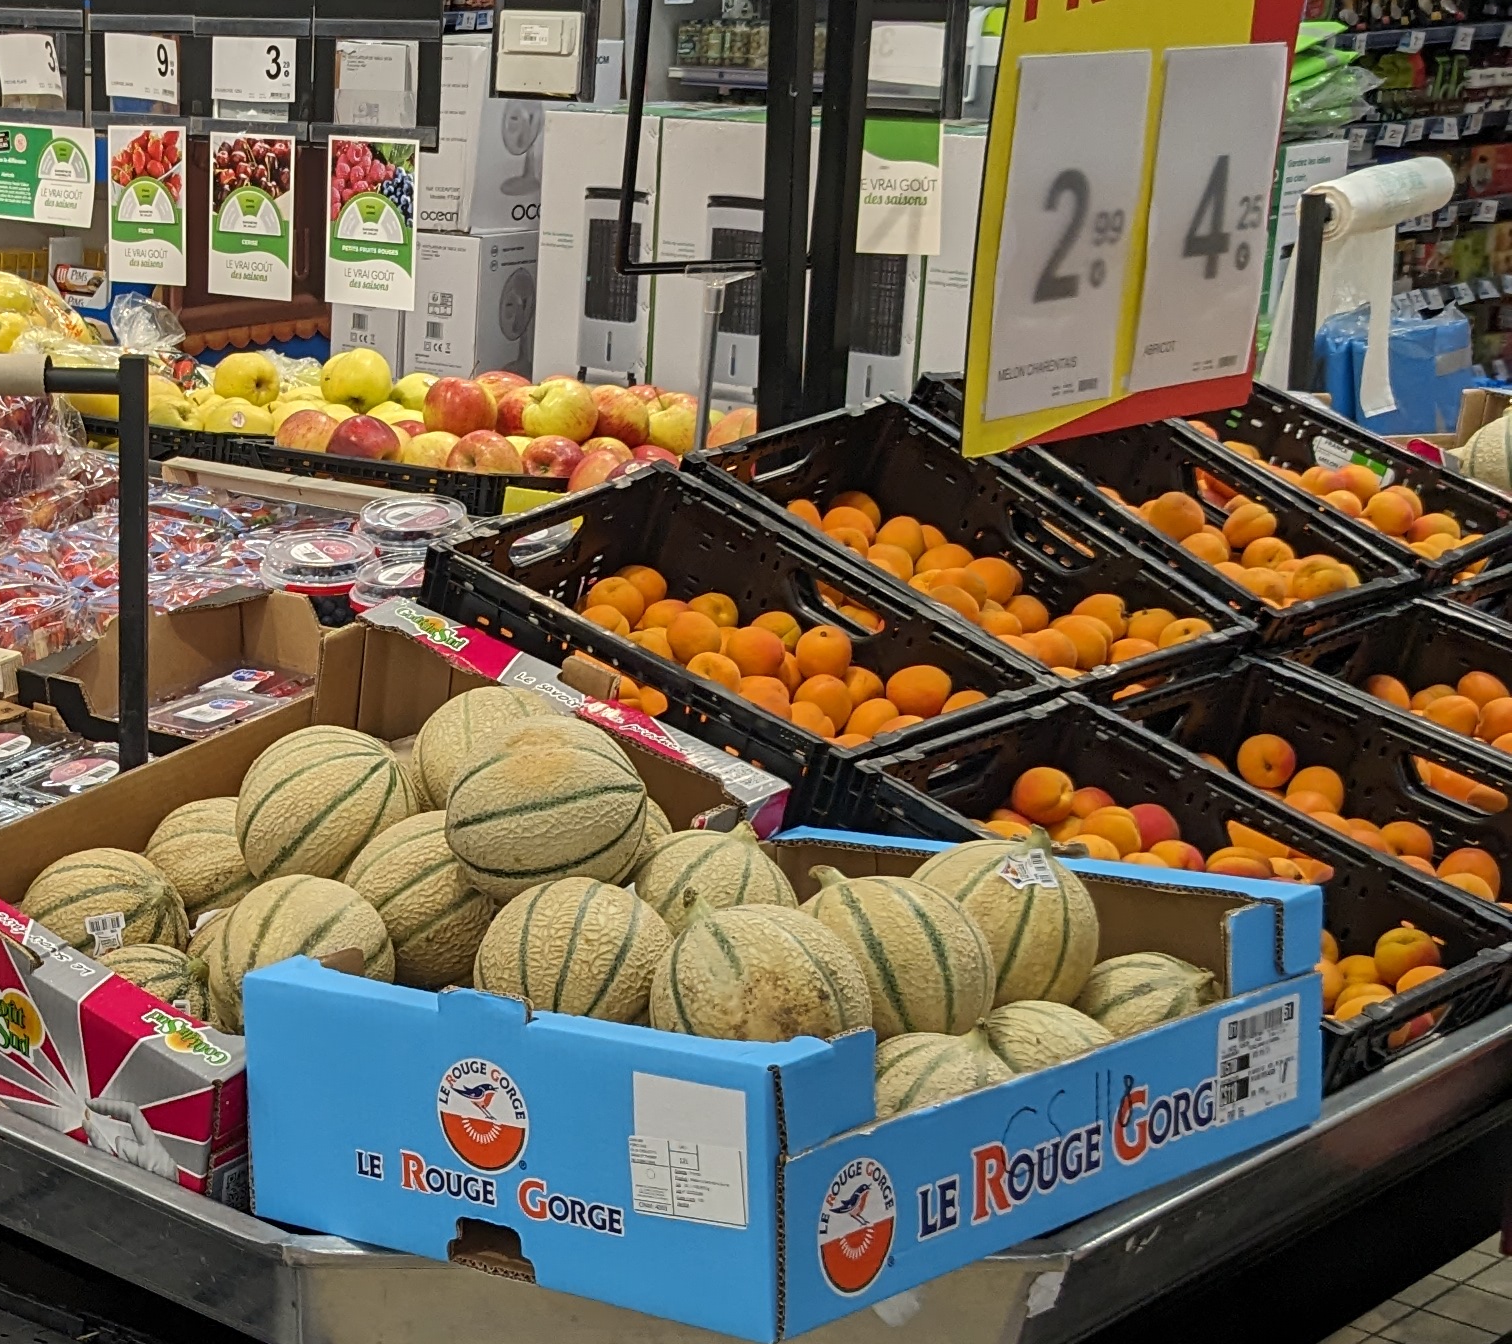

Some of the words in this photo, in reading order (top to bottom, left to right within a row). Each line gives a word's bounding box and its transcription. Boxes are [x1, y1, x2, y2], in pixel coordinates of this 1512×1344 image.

[45, 41, 56, 73] 3
[157, 43, 169, 77] 9
[265, 45, 282, 80] 3
[860, 179, 867, 191] E
[870, 178, 897, 192] VRAI
[900, 174, 937, 192] GOÛT
[864, 192, 883, 205] des
[885, 192, 927, 206] saisons
[420, 210, 460, 222] ocean
[1182, 154, 1232, 280] 4
[1033, 168, 1091, 304] 2
[226, 260, 234, 268] LE
[235, 261, 250, 270] VRAI
[251, 260, 273, 272] GOÛT
[231, 271, 241, 280] des
[242, 272, 268, 282] saisons
[344, 268, 352, 277] LE
[353, 269, 369, 279] VRAI
[370, 268, 394, 282] GOÛT
[349, 280, 361, 289] des
[362, 281, 389, 291] saisons
[514, 672, 533, 684] Le
[439, 1085, 450, 1105] LE
[445, 1060, 487, 1087] ROUGE
[490, 1068, 527, 1121] GORGE
[918, 1175, 960, 1241] LE
[972, 1121, 1103, 1224] ROUGE
[1113, 1079, 1219, 1163] GORG
[356, 1150, 383, 1180] LE
[400, 1149, 496, 1207] ROUGE
[517, 1178, 624, 1236] GORGE
[819, 1212, 828, 1235] LE
[827, 1161, 863, 1208] ROUGE
[866, 1160, 894, 1210] GORGE
